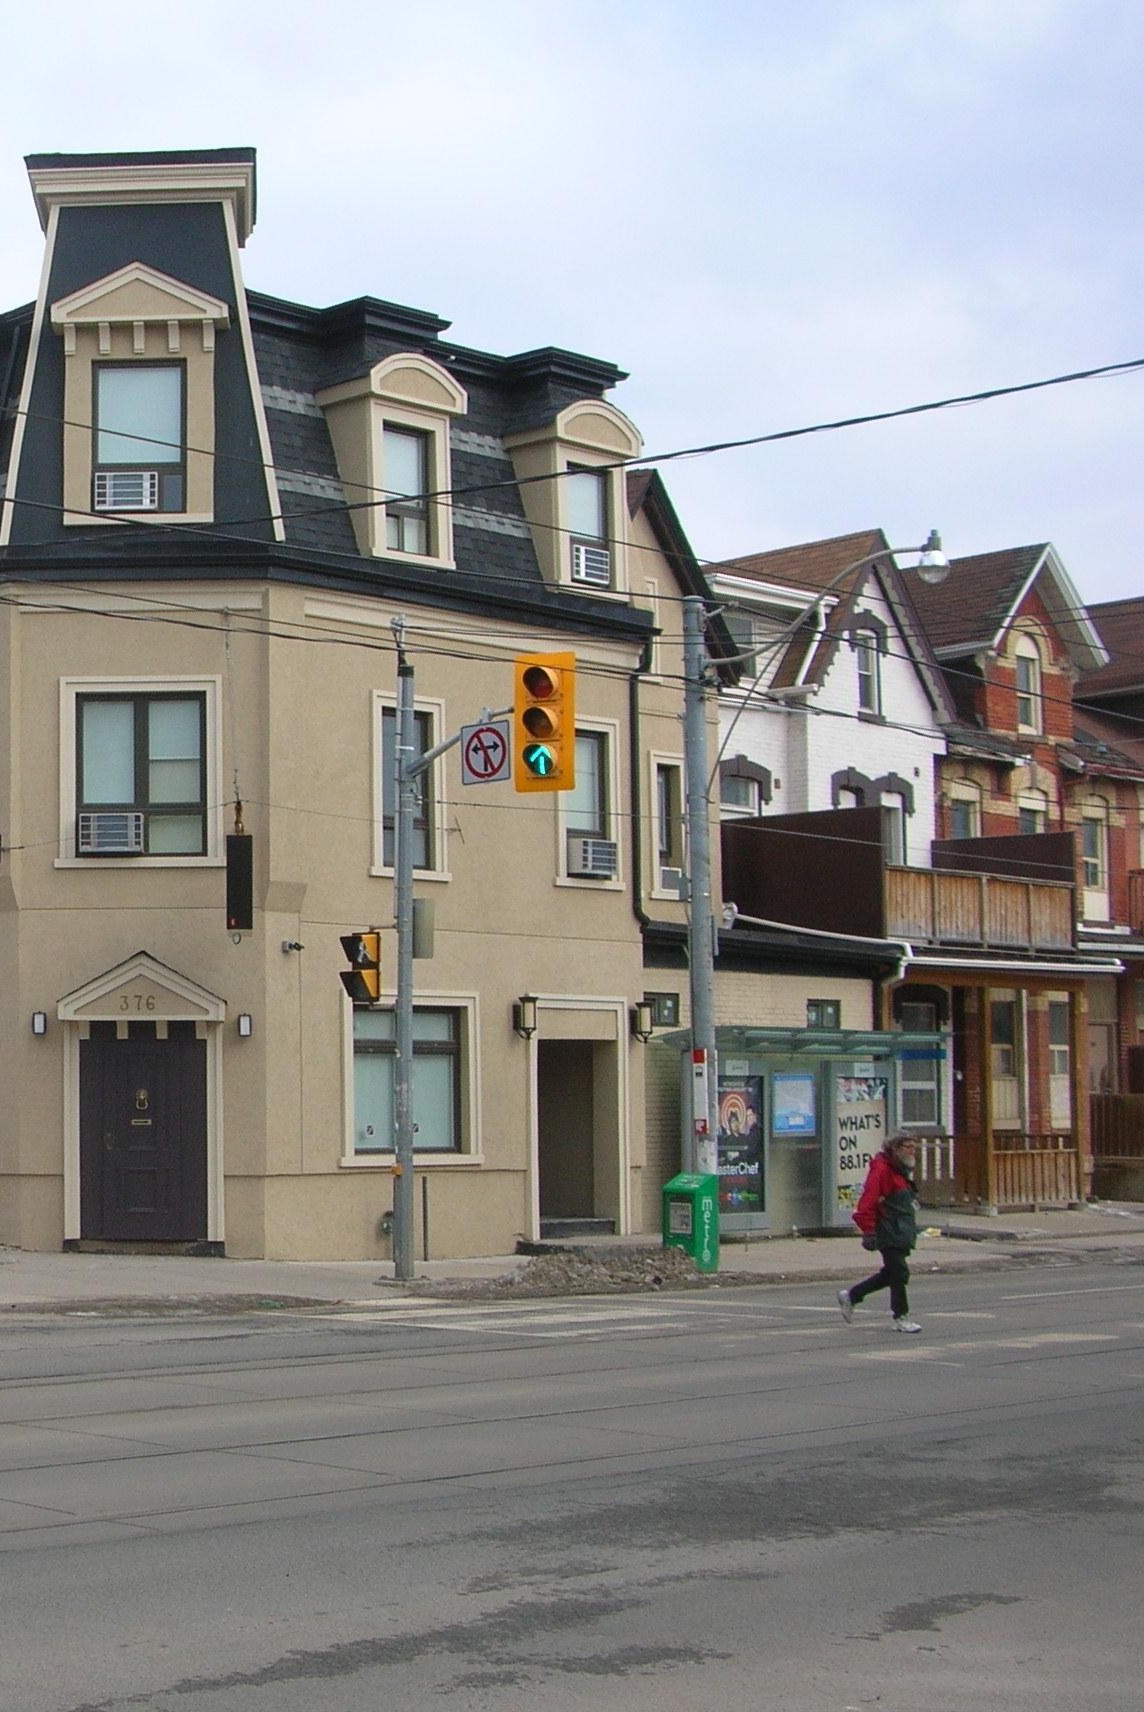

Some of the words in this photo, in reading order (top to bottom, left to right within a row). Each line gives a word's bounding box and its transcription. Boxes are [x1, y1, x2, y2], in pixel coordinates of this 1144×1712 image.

[119, 995, 156, 1011] 376
[838, 1113, 881, 1131] WHAT'S
[839, 1135, 857, 1151] ON
[716, 1161, 760, 1175] asterChef
